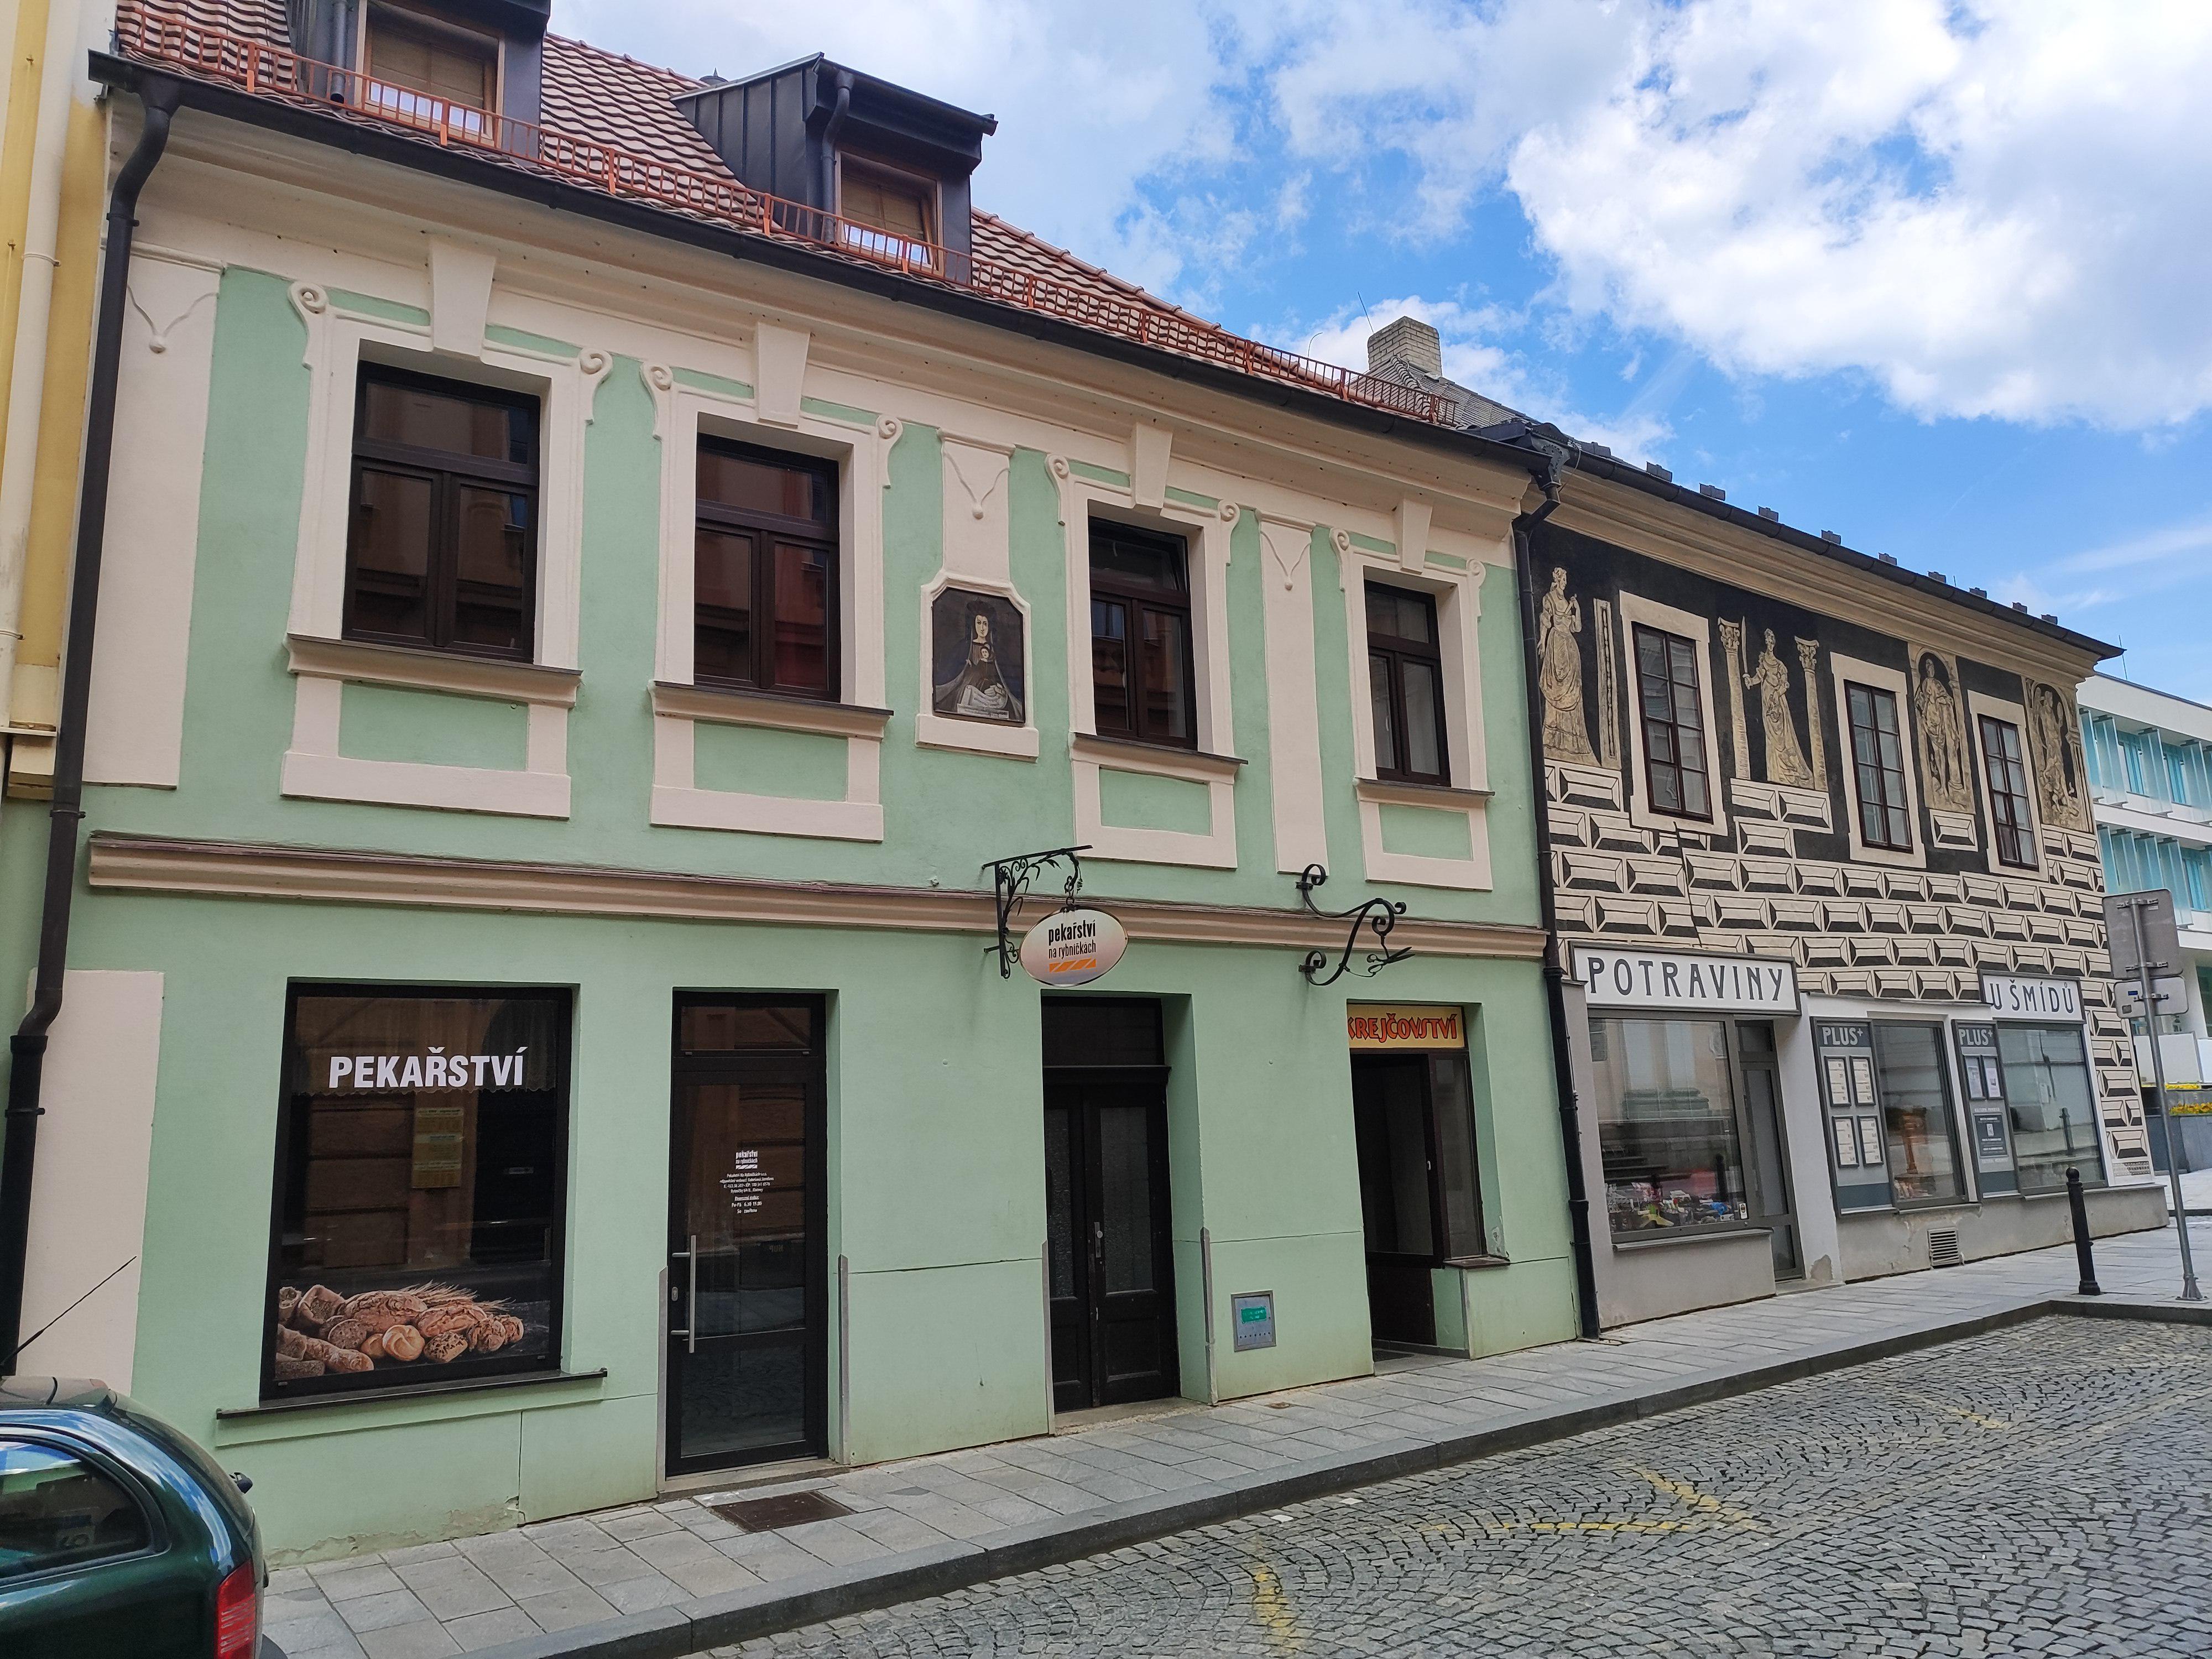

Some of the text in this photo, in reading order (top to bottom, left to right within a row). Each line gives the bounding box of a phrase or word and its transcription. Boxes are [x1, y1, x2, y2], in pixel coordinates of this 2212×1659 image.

[1048, 919, 1096, 946] pekařství
[1048, 940, 1096, 959] na rybníčkách
[1587, 957, 1783, 1001] POTRAVINY
[1990, 979, 2074, 1014] U ŠMÍDŮ
[329, 1046, 528, 1088] PEKAŘSTVÍ
